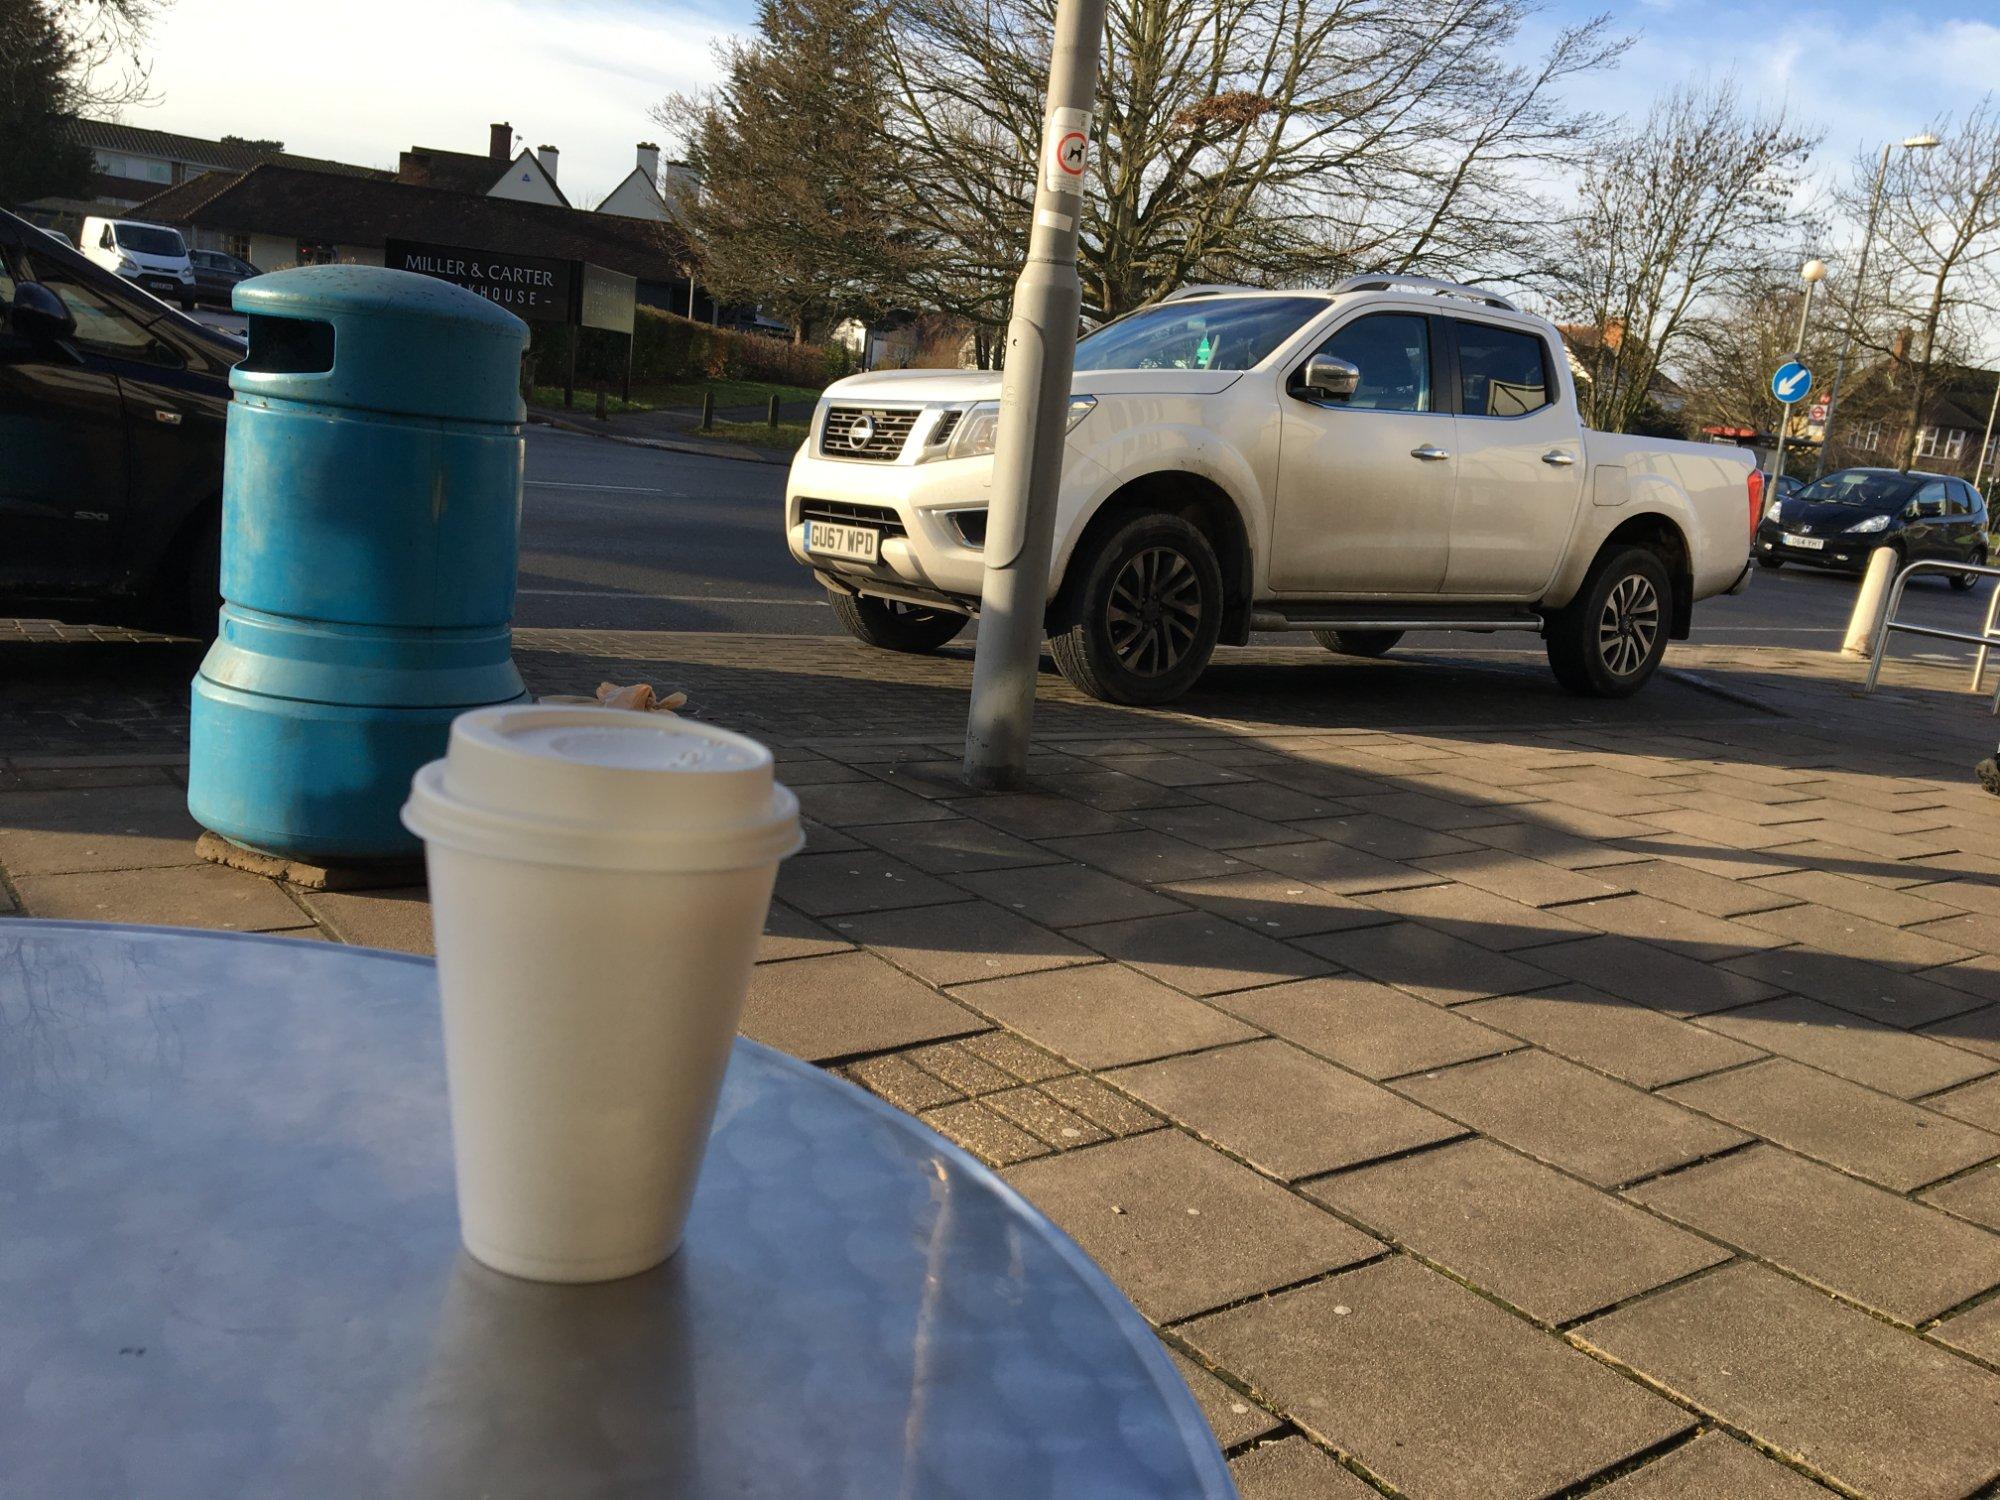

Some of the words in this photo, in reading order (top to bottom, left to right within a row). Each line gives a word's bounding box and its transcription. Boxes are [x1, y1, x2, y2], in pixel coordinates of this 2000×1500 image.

[405, 254, 466, 276] MILLER
[470, 262, 484, 279] &
[488, 264, 553, 287] CARTER
[811, 524, 844, 552] GU67
[847, 529, 874, 555] WPD
